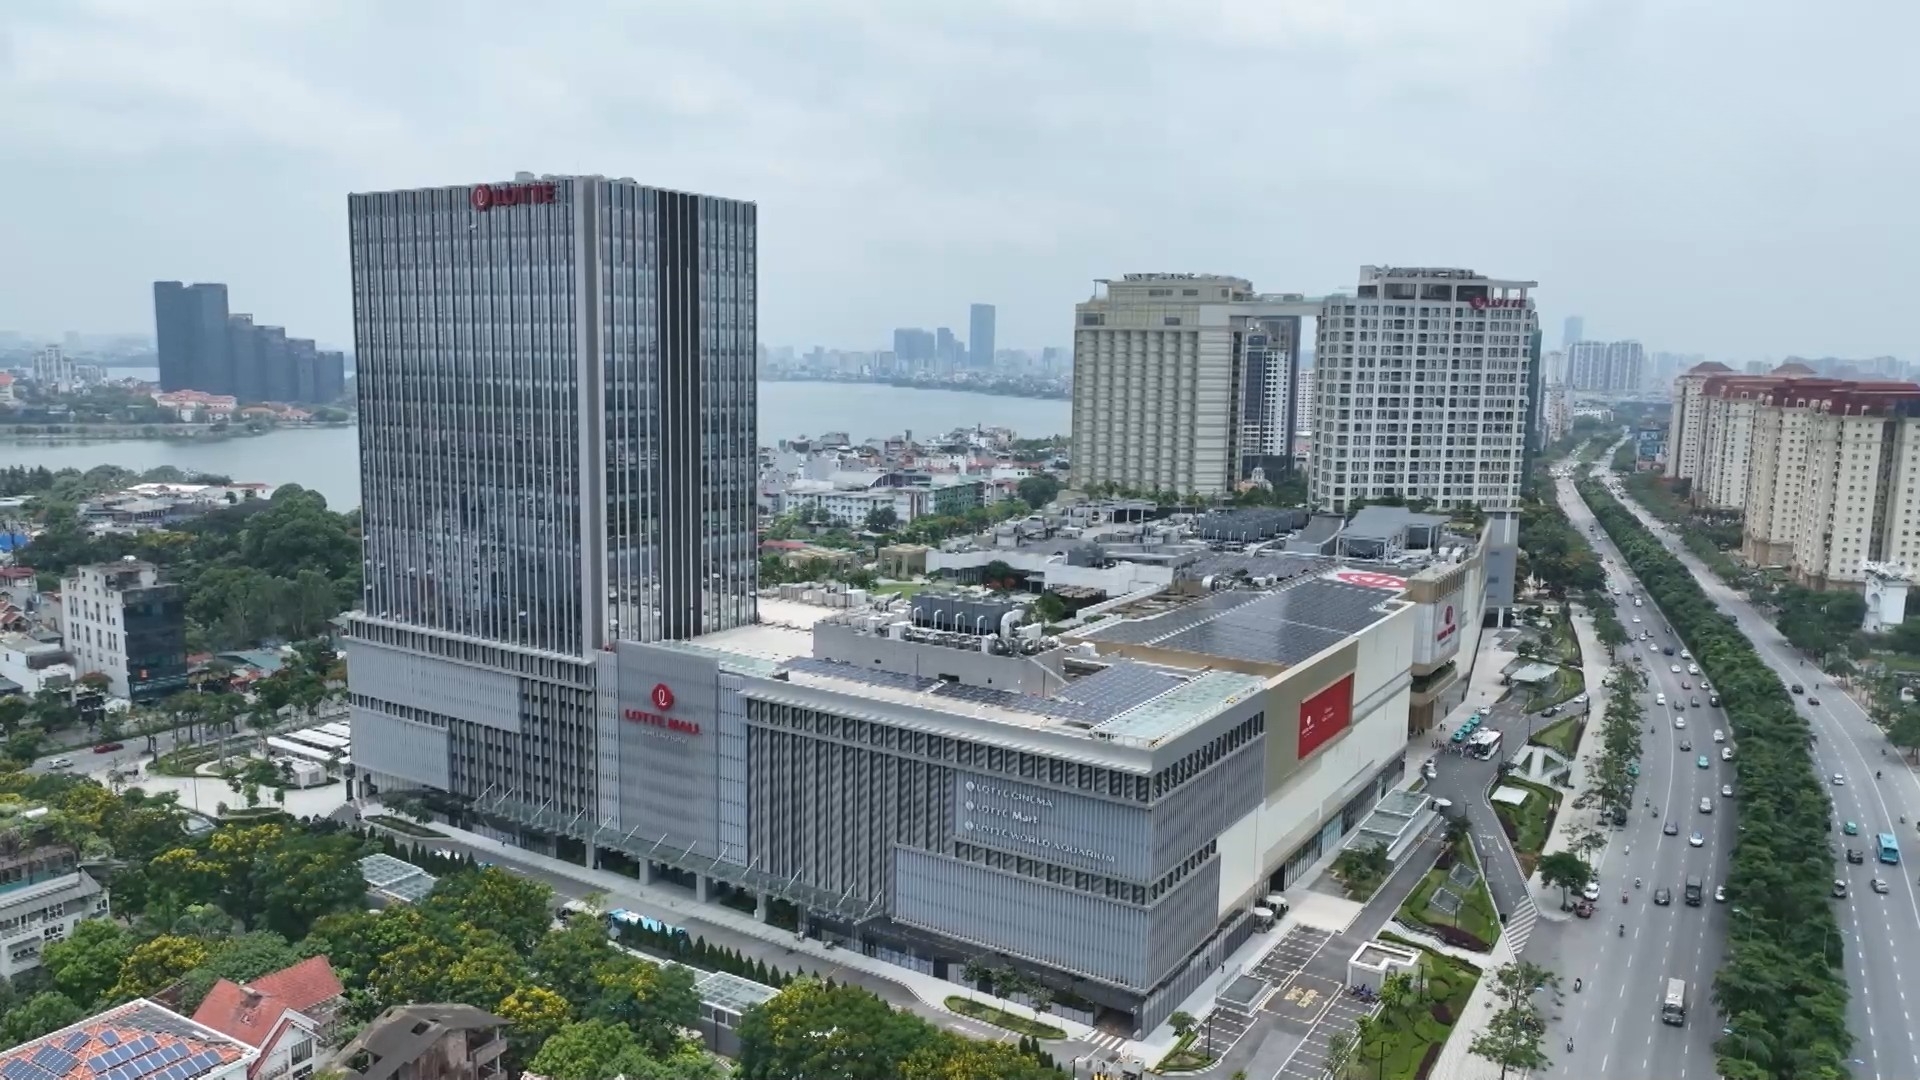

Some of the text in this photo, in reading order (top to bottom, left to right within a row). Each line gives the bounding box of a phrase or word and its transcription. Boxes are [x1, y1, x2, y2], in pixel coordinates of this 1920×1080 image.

[625, 709, 666, 729] LOTTE
[976, 784, 1054, 809] LOTTE CINEMA
[976, 804, 1039, 825] LOTTE Mart
[975, 823, 1116, 864] LOTTE WORLD AQUARIUM
